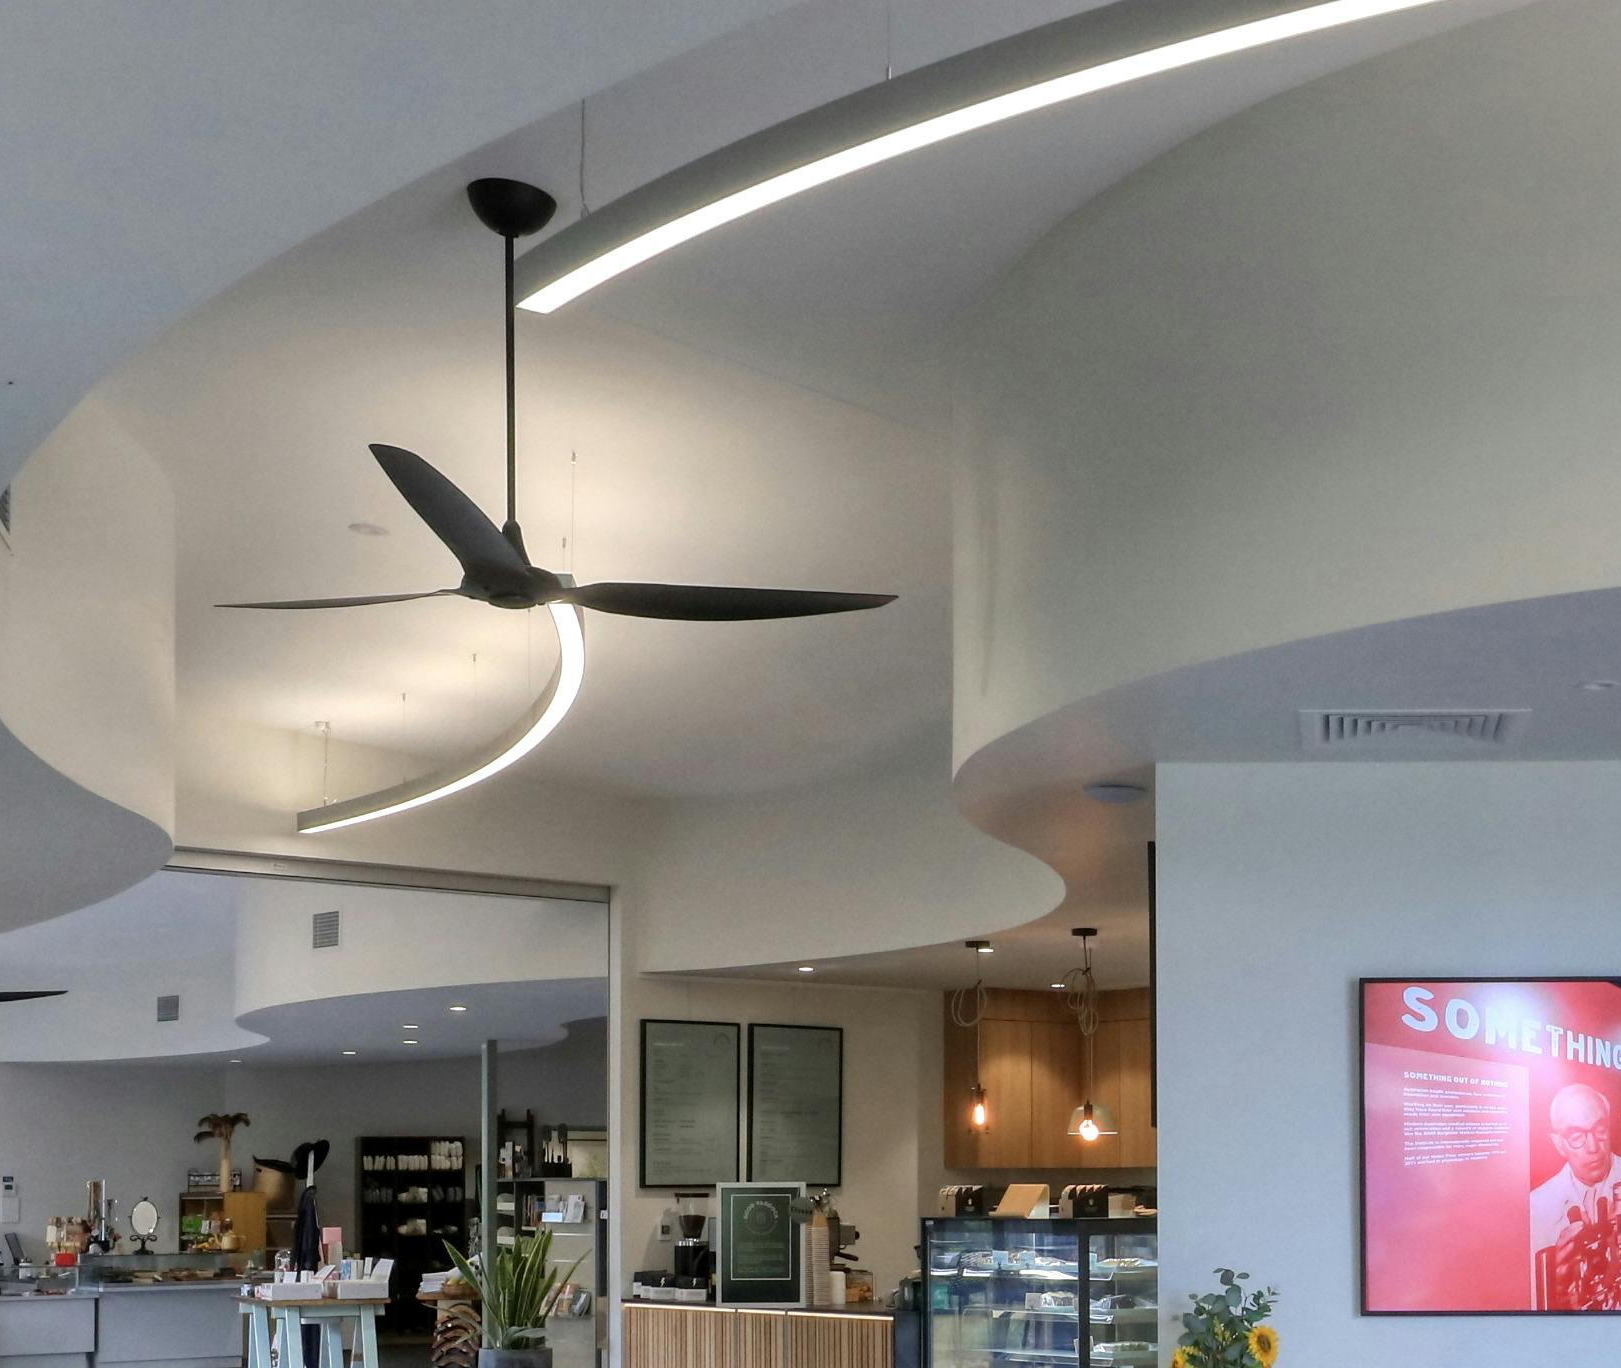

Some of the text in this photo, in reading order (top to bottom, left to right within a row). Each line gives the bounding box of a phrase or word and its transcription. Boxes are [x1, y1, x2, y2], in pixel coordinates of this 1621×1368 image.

[1403, 1071, 1509, 1088] SOMETHING OUT OF NOTHING
